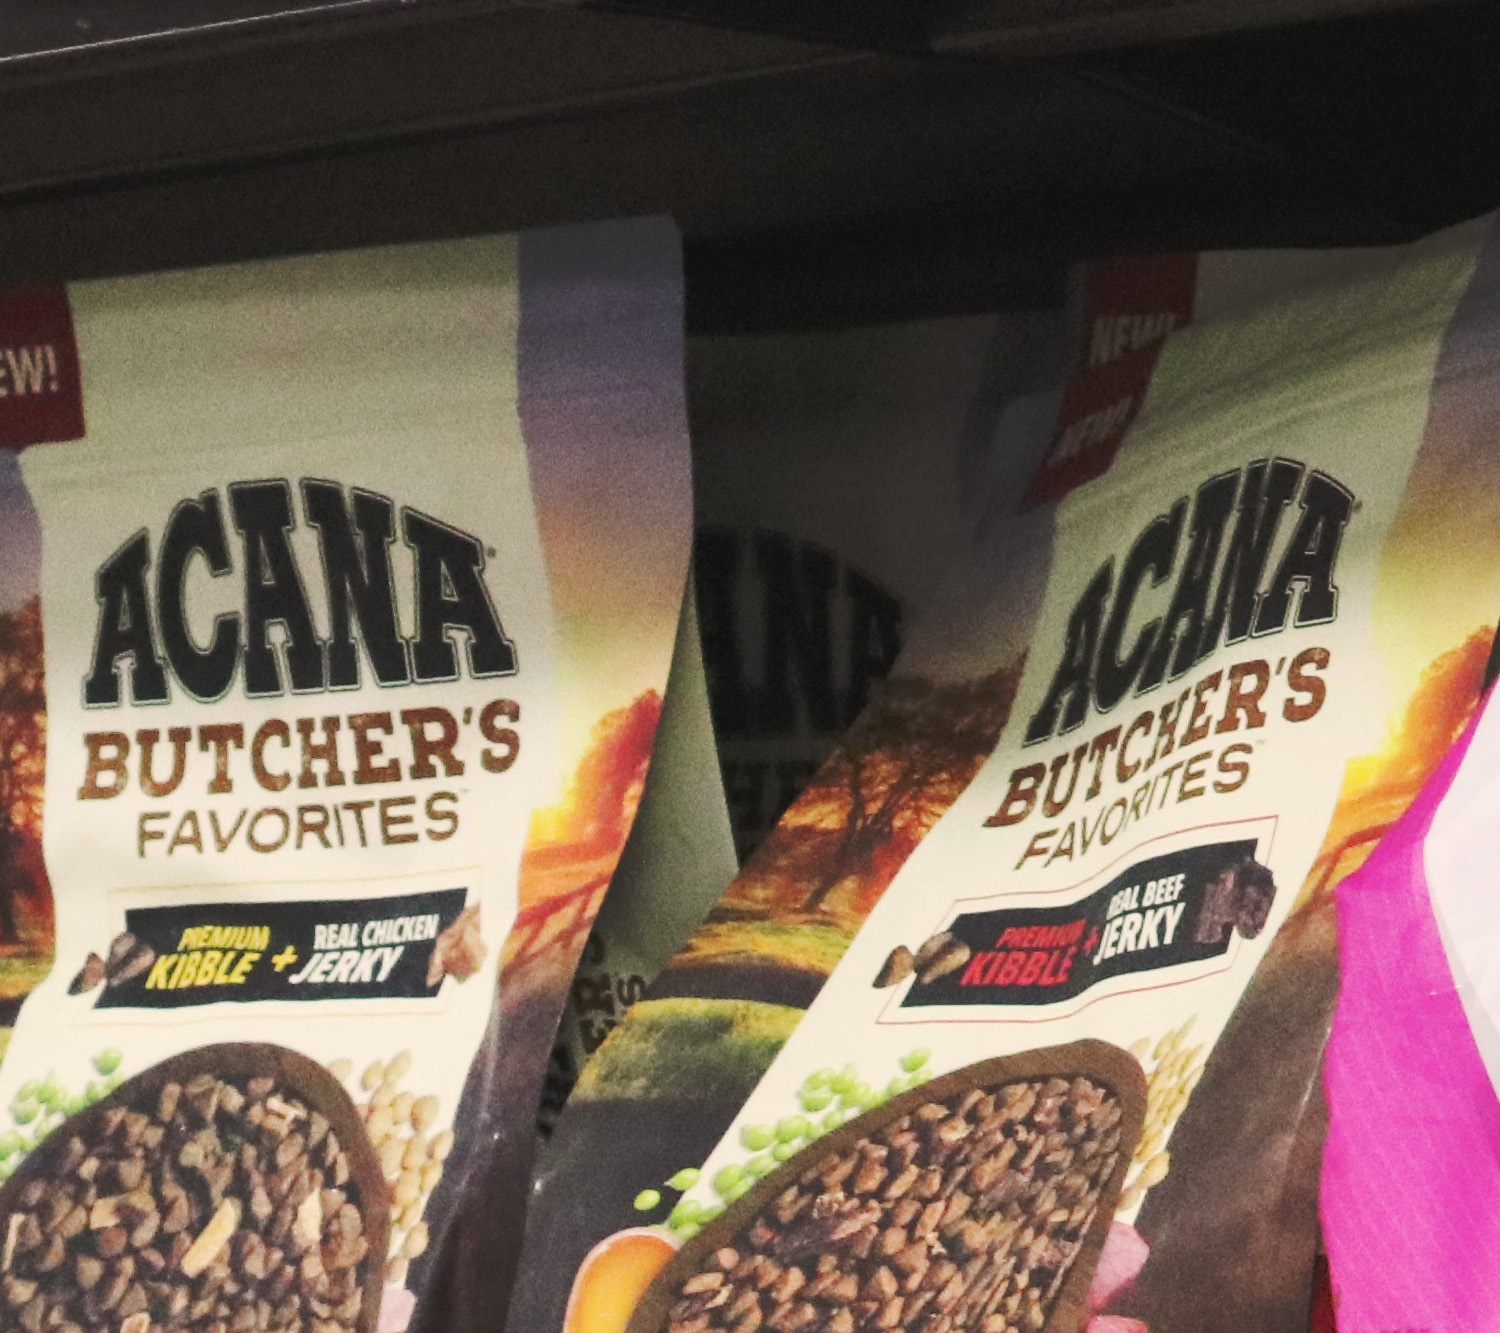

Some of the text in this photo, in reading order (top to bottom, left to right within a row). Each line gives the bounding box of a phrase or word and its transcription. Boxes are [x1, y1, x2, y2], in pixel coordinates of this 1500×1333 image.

[81, 478, 517, 709] ACANA
[1023, 456, 1358, 749] ACANA
[76, 700, 522, 802] BUTCHER'S
[983, 646, 1332, 830] BUTCHER'S
[137, 791, 460, 858] FAVORITES
[1013, 743, 1255, 872] FAVORITES
[1144, 873, 1186, 902] BEEF
[145, 913, 440, 990] PREMIUM KIBBLE REAL CHICKEN JERKY
[959, 947, 1077, 987] KIBBLE
[1093, 903, 1186, 966] JERKY
